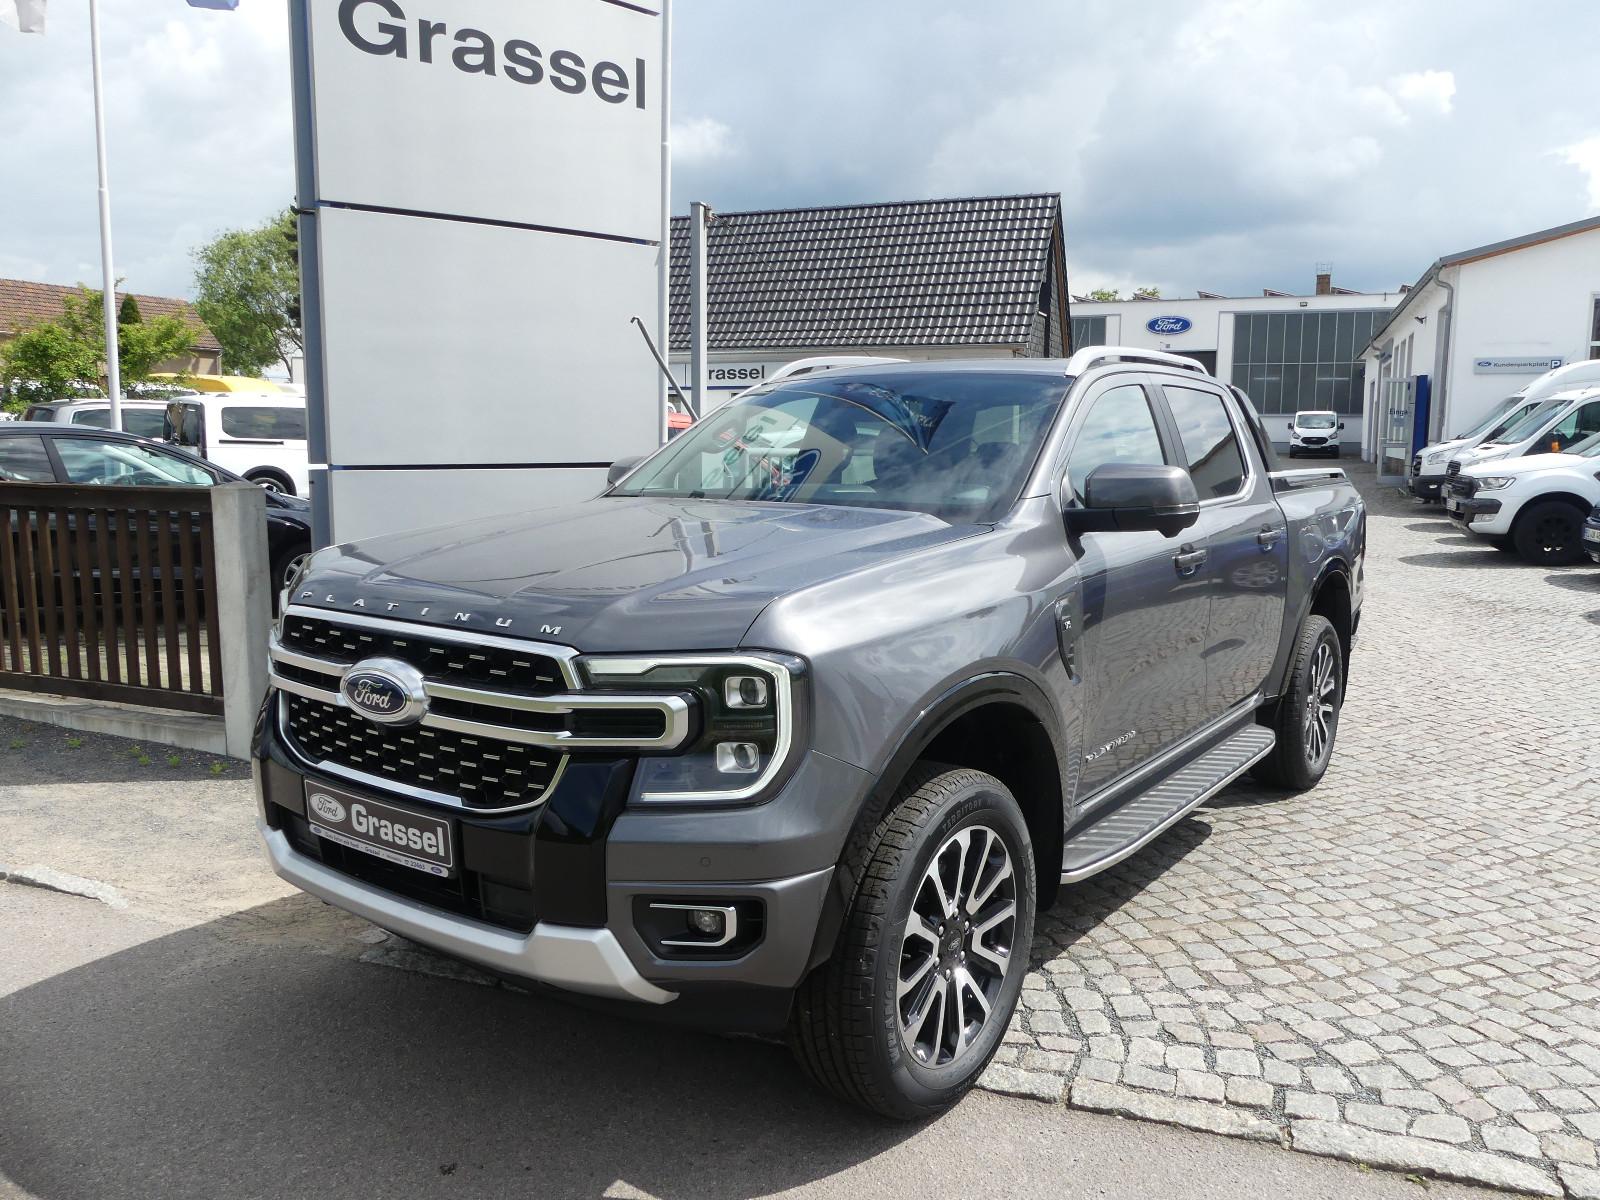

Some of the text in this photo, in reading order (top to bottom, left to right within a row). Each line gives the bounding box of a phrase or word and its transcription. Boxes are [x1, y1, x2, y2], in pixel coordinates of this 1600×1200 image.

[337, 0, 646, 110] Grassel
[708, 364, 765, 380] rassel
[1551, 360, 1561, 369] P
[301, 591, 562, 635] PLATINUM
[354, 679, 391, 708] Ford
[317, 797, 339, 818] Ford
[351, 803, 445, 856] Grassel
